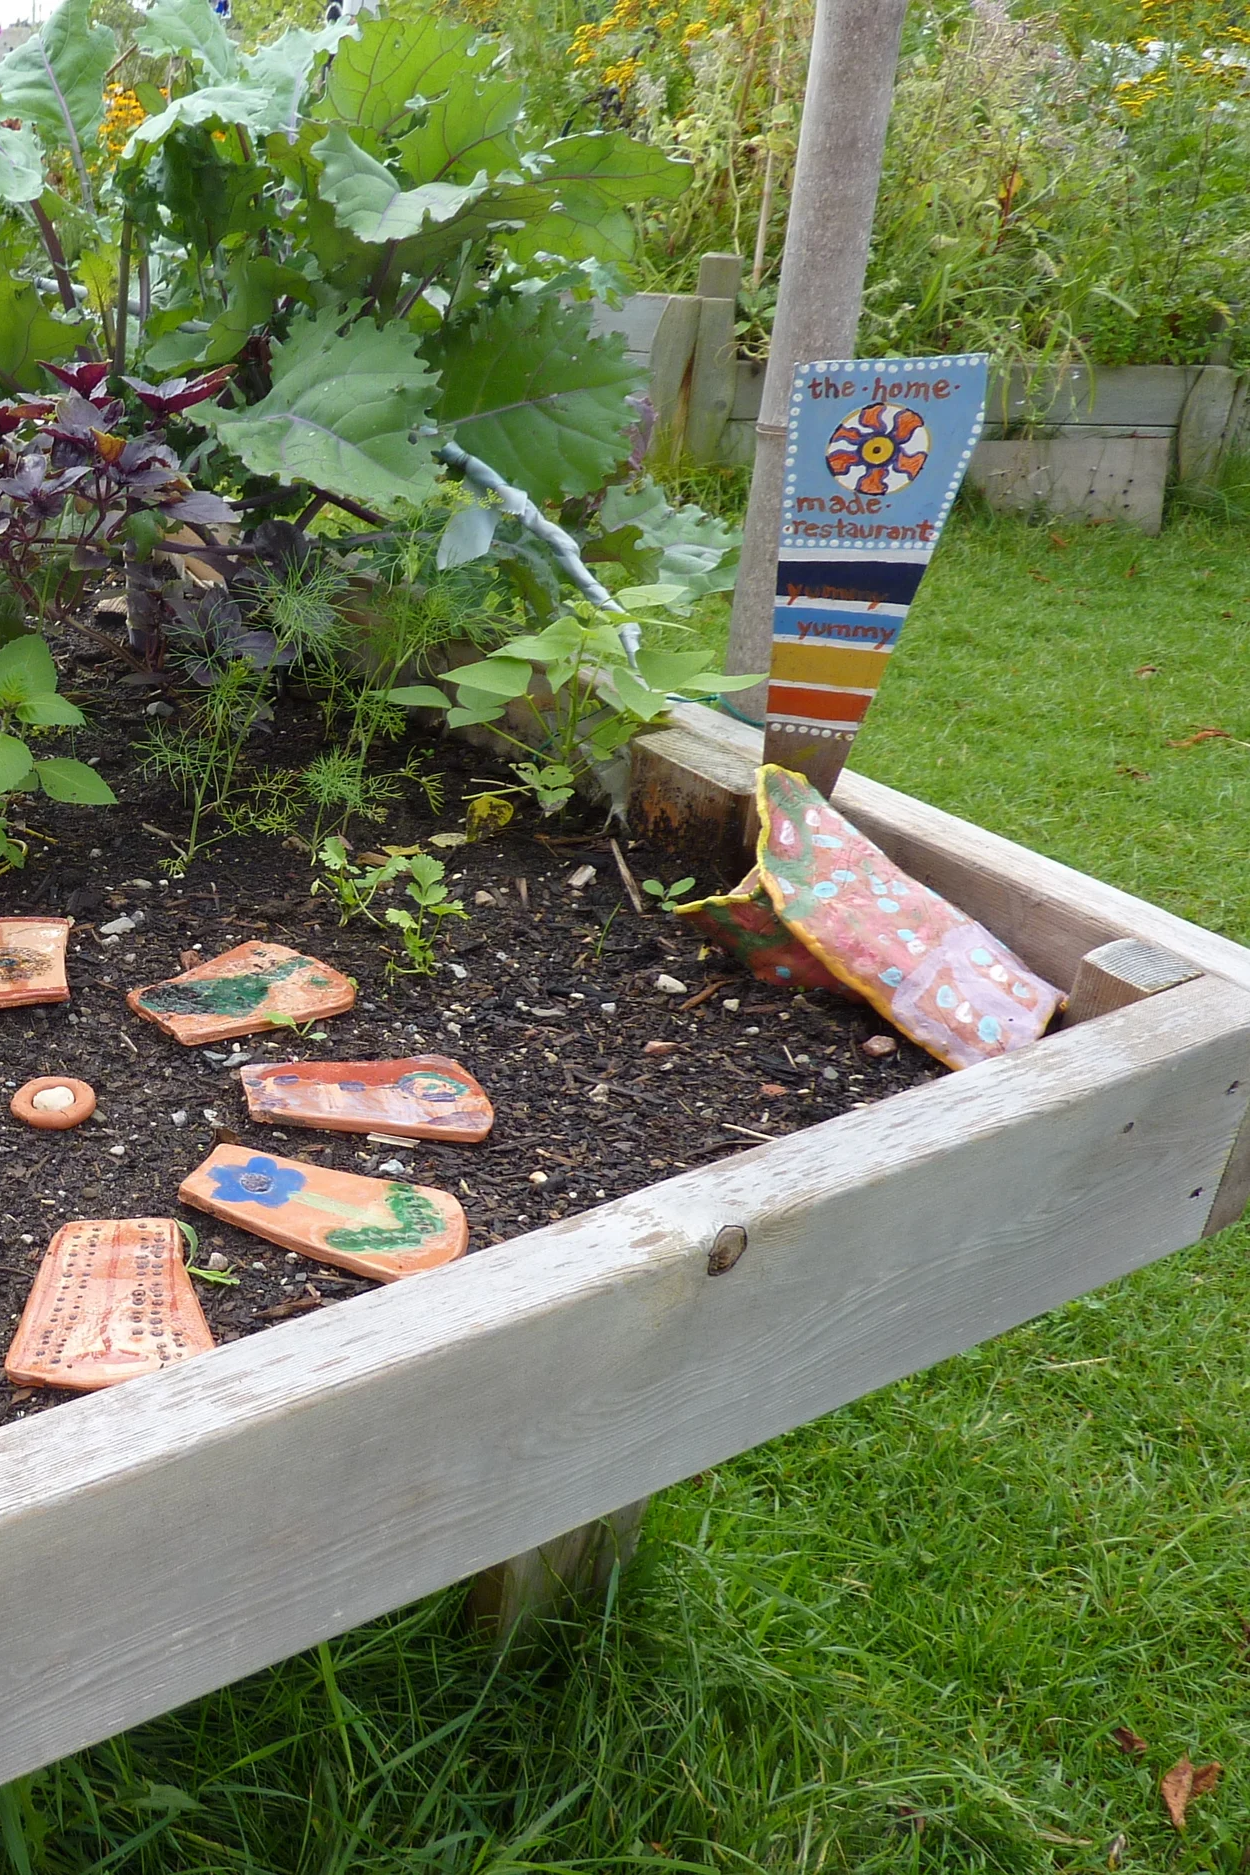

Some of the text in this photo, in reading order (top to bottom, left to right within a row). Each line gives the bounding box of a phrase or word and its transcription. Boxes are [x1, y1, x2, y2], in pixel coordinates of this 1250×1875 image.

[807, 376, 952, 403] the home
[795, 492, 882, 516] made
[791, 517, 935, 542] restaurant
[786, 583, 889, 611] yummy
[797, 620, 895, 651] yummy
